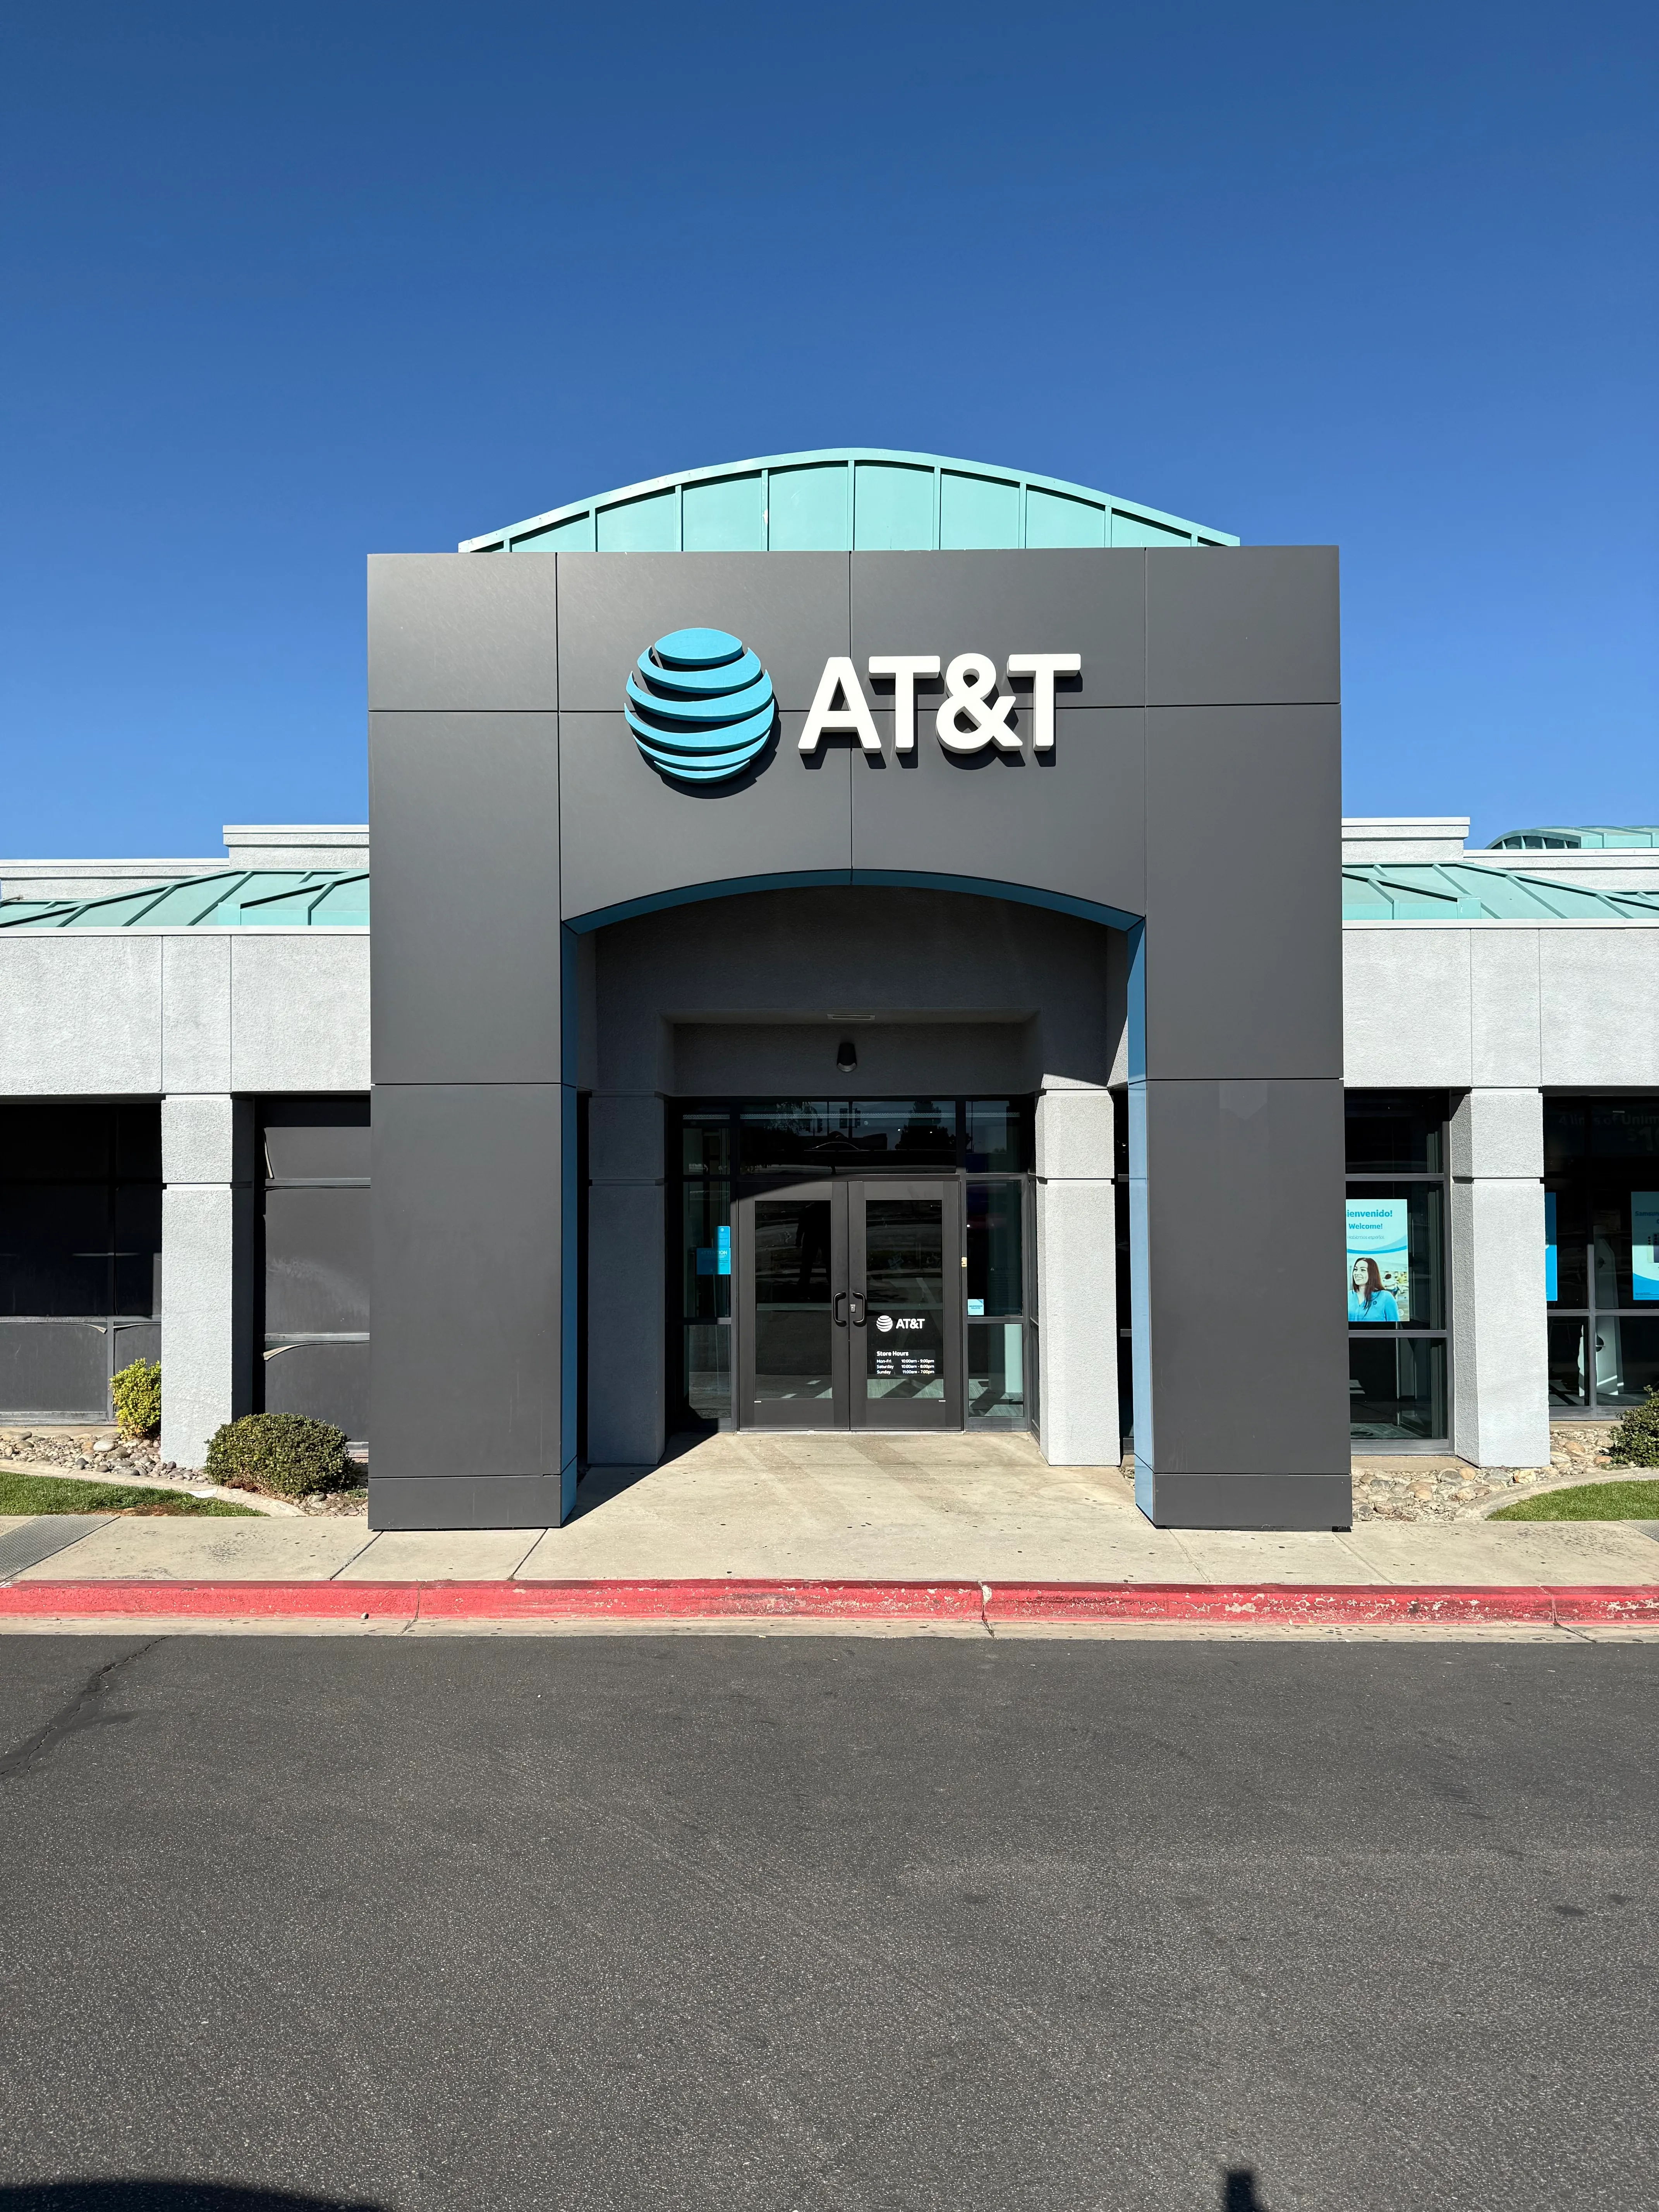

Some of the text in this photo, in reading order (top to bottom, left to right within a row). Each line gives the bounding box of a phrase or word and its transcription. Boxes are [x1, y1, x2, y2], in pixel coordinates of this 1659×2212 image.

[798, 653, 1081, 754] AT&T
[1570, 1114, 1601, 1125] lins
[1603, 1113, 1620, 1125] of
[896, 1318, 925, 1329] AT&T
